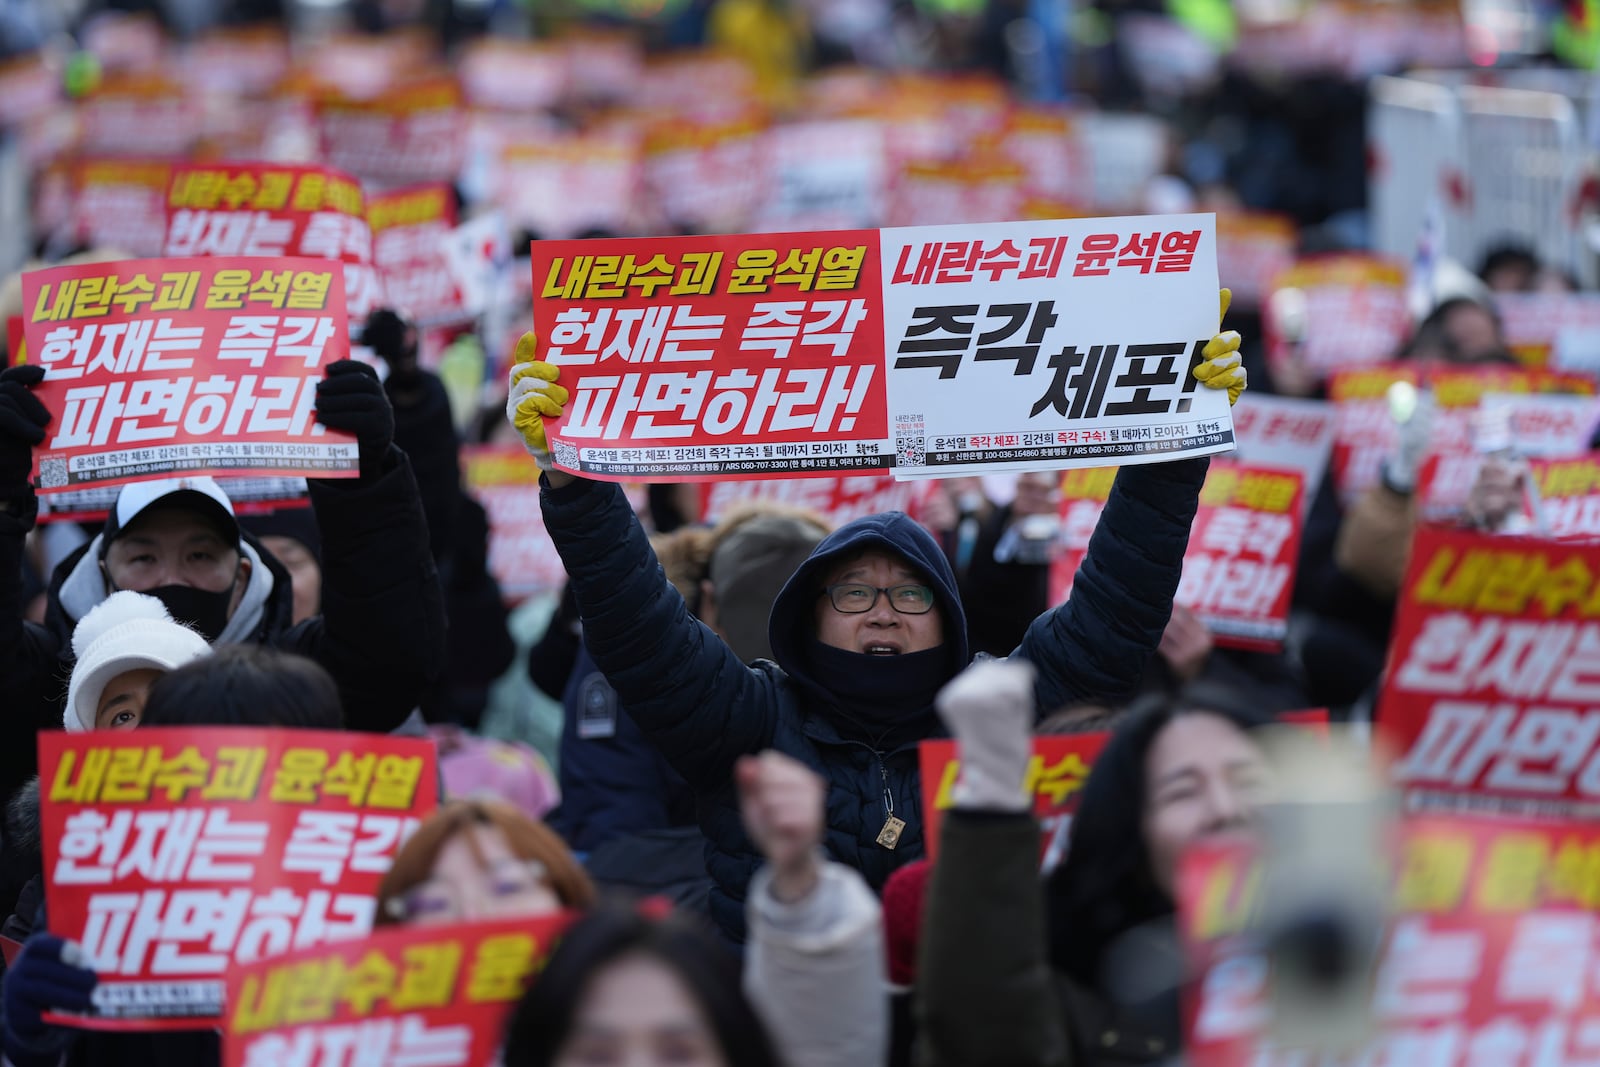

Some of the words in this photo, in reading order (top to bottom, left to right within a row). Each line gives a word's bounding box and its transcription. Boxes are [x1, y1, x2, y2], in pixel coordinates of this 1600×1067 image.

[541, 251, 724, 299] 내란수괴
[727, 246, 867, 293] 윤석열
[890, 236, 1068, 285] 내란수괴
[1072, 230, 1202, 277] 윤석열
[31, 271, 201, 323] 내란수괴
[204, 269, 332, 310] 윤석열
[39, 318, 205, 382] 헌재는
[217, 315, 336, 368] 즉각
[545, 304, 726, 366] 헌재는
[739, 299, 868, 359] 즉각
[893, 300, 1059, 380] 즉각
[559, 364, 876, 440] 파면하라!
[1029, 339, 1210, 420] 체포!
[76, 455, 106, 469] 윤석열
[109, 453, 129, 464] 즉각
[131, 450, 155, 461] 체포!
[159, 448, 188, 459] 김건희
[192, 445, 211, 456] 즉각
[215, 444, 239, 456] 구속!
[254, 444, 284, 456] 때까지
[287, 445, 320, 456] 모이자!
[587, 450, 618, 461] 윤석열
[621, 450, 643, 461] 즉각
[645, 449, 670, 461] 체포!
[674, 448, 706, 460] 김건희
[709, 447, 730, 459] 즉각
[733, 447, 759, 458] 구속!
[776, 444, 808, 456] 때까지
[811, 443, 848, 455] 모이자!
[607, 464, 634, 473] 신한은행
[636, 464, 691, 473] 100-036-164860
[741, 461, 788, 469] 060-707-3300
[816, 459, 827, 467] 1만
[839, 458, 854, 466] 여러
[935, 437, 967, 449] 윤석열
[969, 436, 991, 448] 즉각
[994, 435, 1019, 447] 체포!
[1023, 433, 1054, 446] 김건희
[1057, 431, 1078, 444] 즉각
[1081, 430, 1106, 443] 구속!
[1110, 429, 1120, 441] 될
[1122, 428, 1151, 440] 때까지
[1154, 425, 1189, 438] 모이자!
[936, 454, 950, 462] 후원
[956, 452, 983, 461] 신한은행
[984, 449, 1039, 459] 100-036-164860
[1073, 447, 1088, 455] ARS
[1088, 445, 1134, 454] 060-707-3300
[1183, 438, 1196, 447] 여러
[1416, 547, 1600, 618] 내란수
[49, 747, 267, 803] 내란수괴
[271, 749, 423, 809] 윤석열
[1393, 701, 1600, 794] 파면
[53, 808, 268, 884] 헌재는
